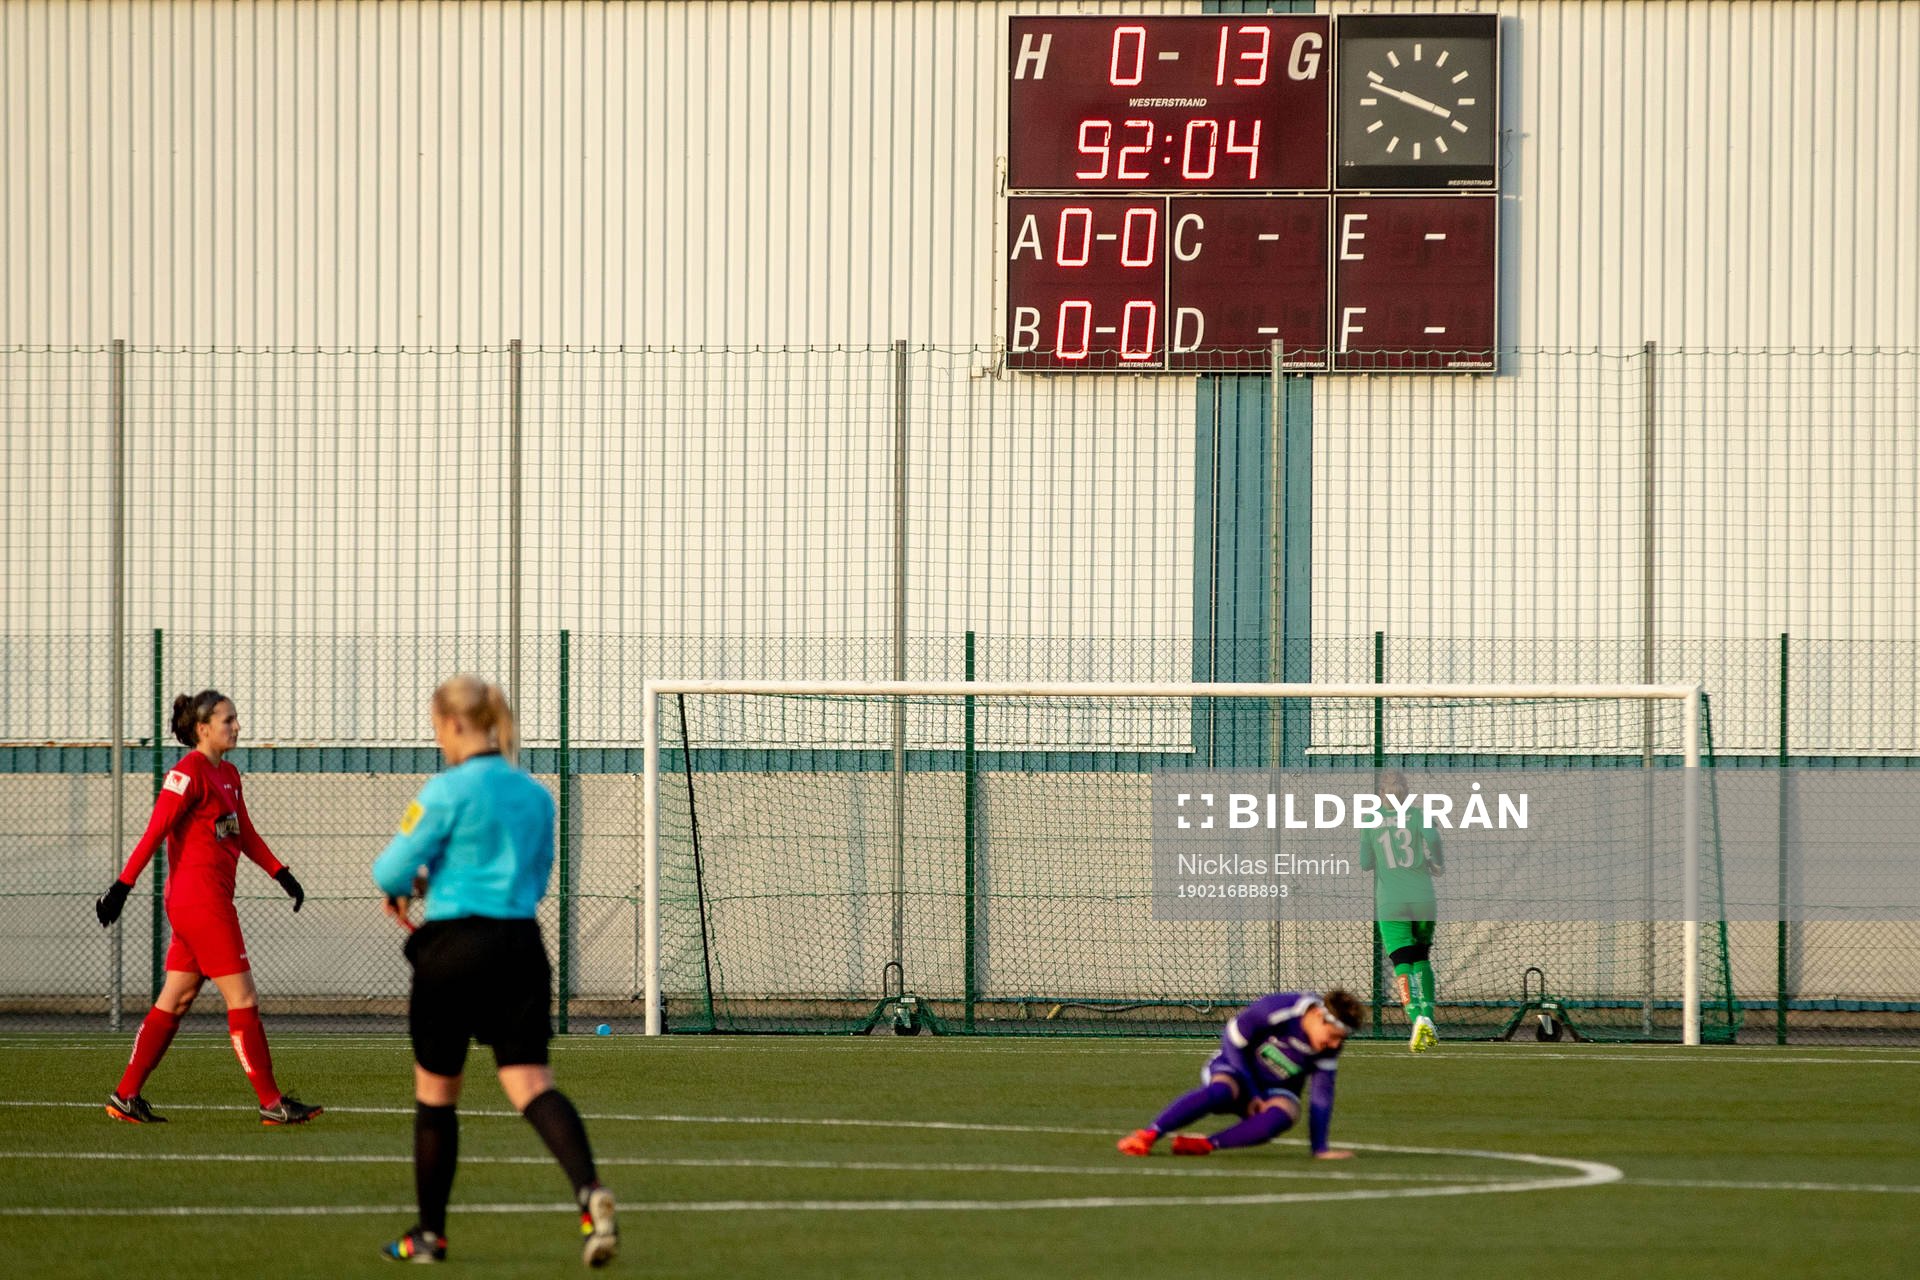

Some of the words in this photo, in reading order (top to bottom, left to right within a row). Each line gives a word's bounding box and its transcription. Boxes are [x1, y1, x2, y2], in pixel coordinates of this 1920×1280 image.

[1013, 33, 1052, 80] H
[1109, 26, 1147, 86] 0
[1216, 26, 1271, 86] 13
[1287, 32, 1323, 81] G
[1129, 97, 1208, 108] WESTERSTRAND
[1076, 119, 1262, 180] 92:04
[1447, 179, 1494, 187] WESTERSTRAND
[1011, 213, 1043, 261] A
[1174, 213, 1205, 262] C
[1340, 213, 1368, 261] E
[1012, 306, 1041, 353] B
[1174, 307, 1206, 353] D
[1340, 307, 1368, 353] F
[1377, 829, 1415, 869] 13
